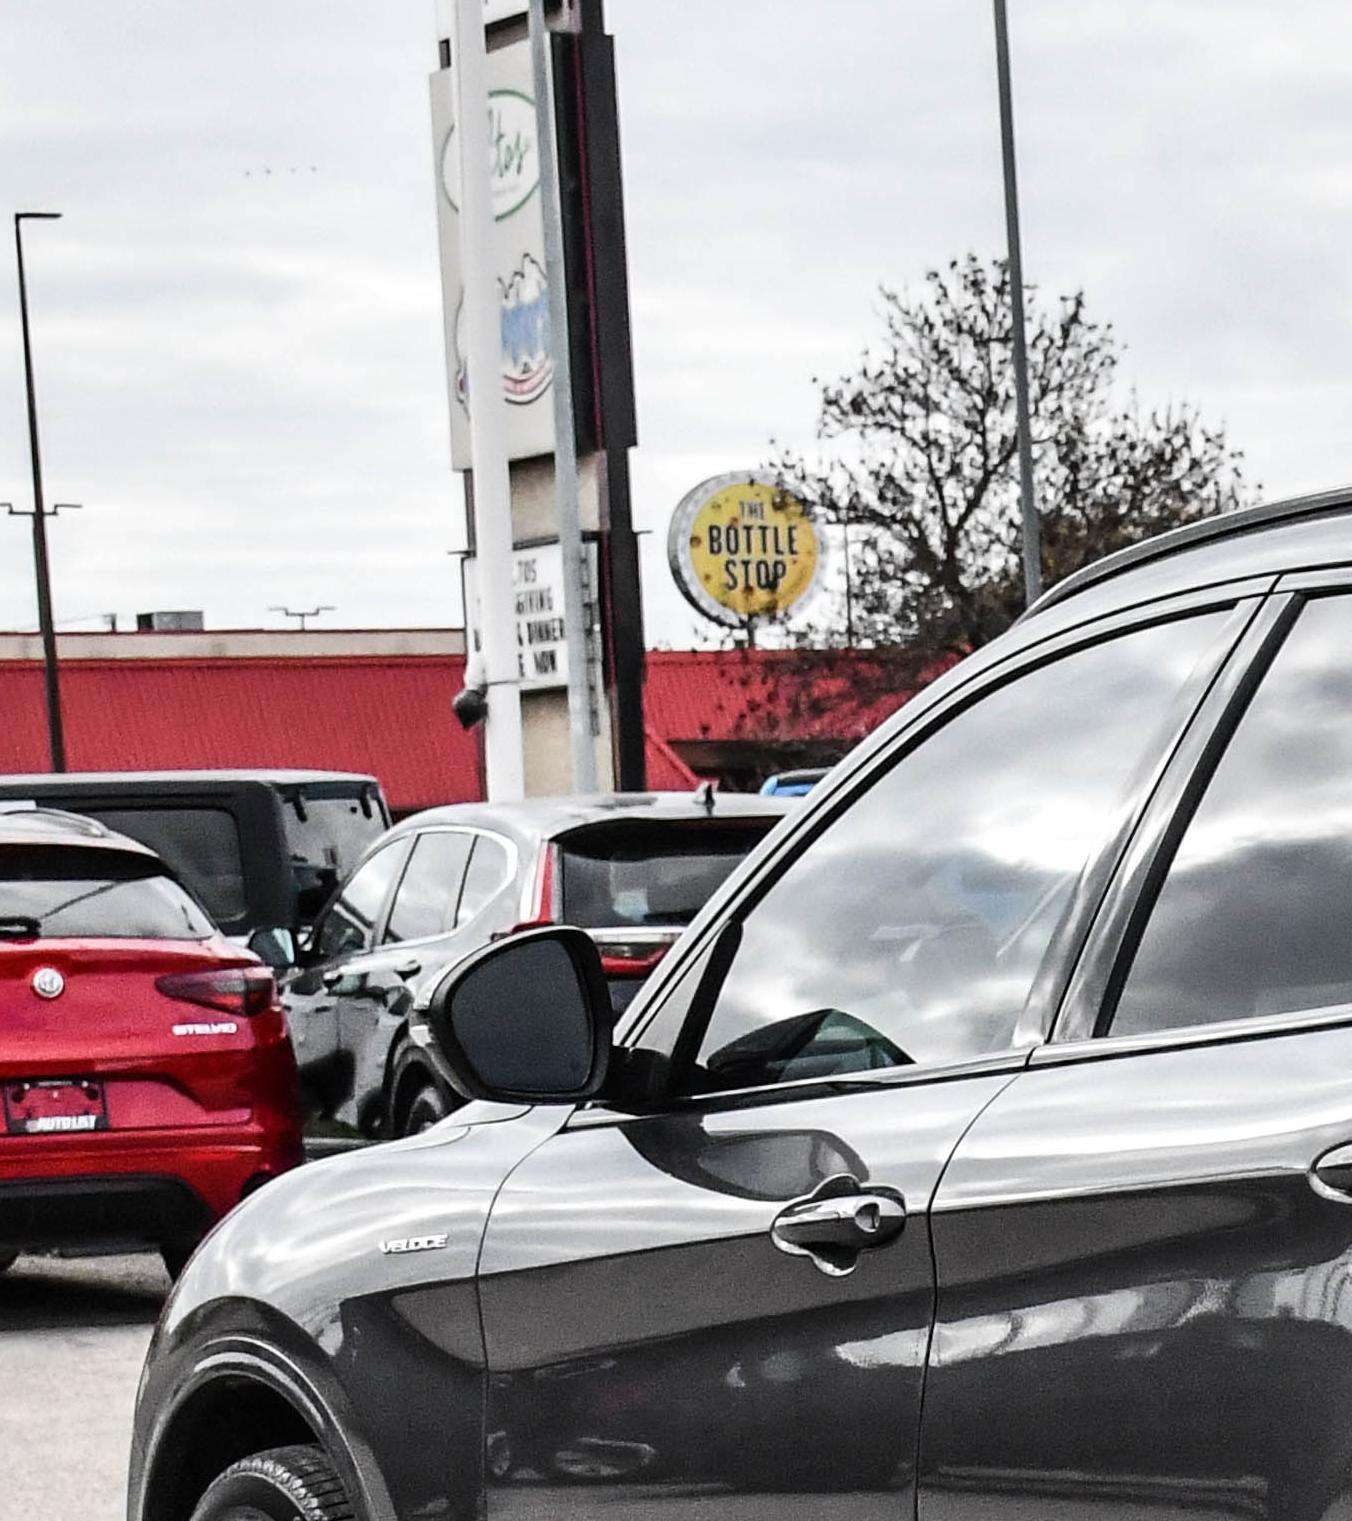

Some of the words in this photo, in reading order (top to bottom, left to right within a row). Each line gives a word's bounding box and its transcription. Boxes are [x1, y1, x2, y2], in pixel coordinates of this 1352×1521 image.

[739, 500, 764, 520] THE
[708, 524, 798, 555] BOTTLE
[724, 558, 787, 591] STOP
